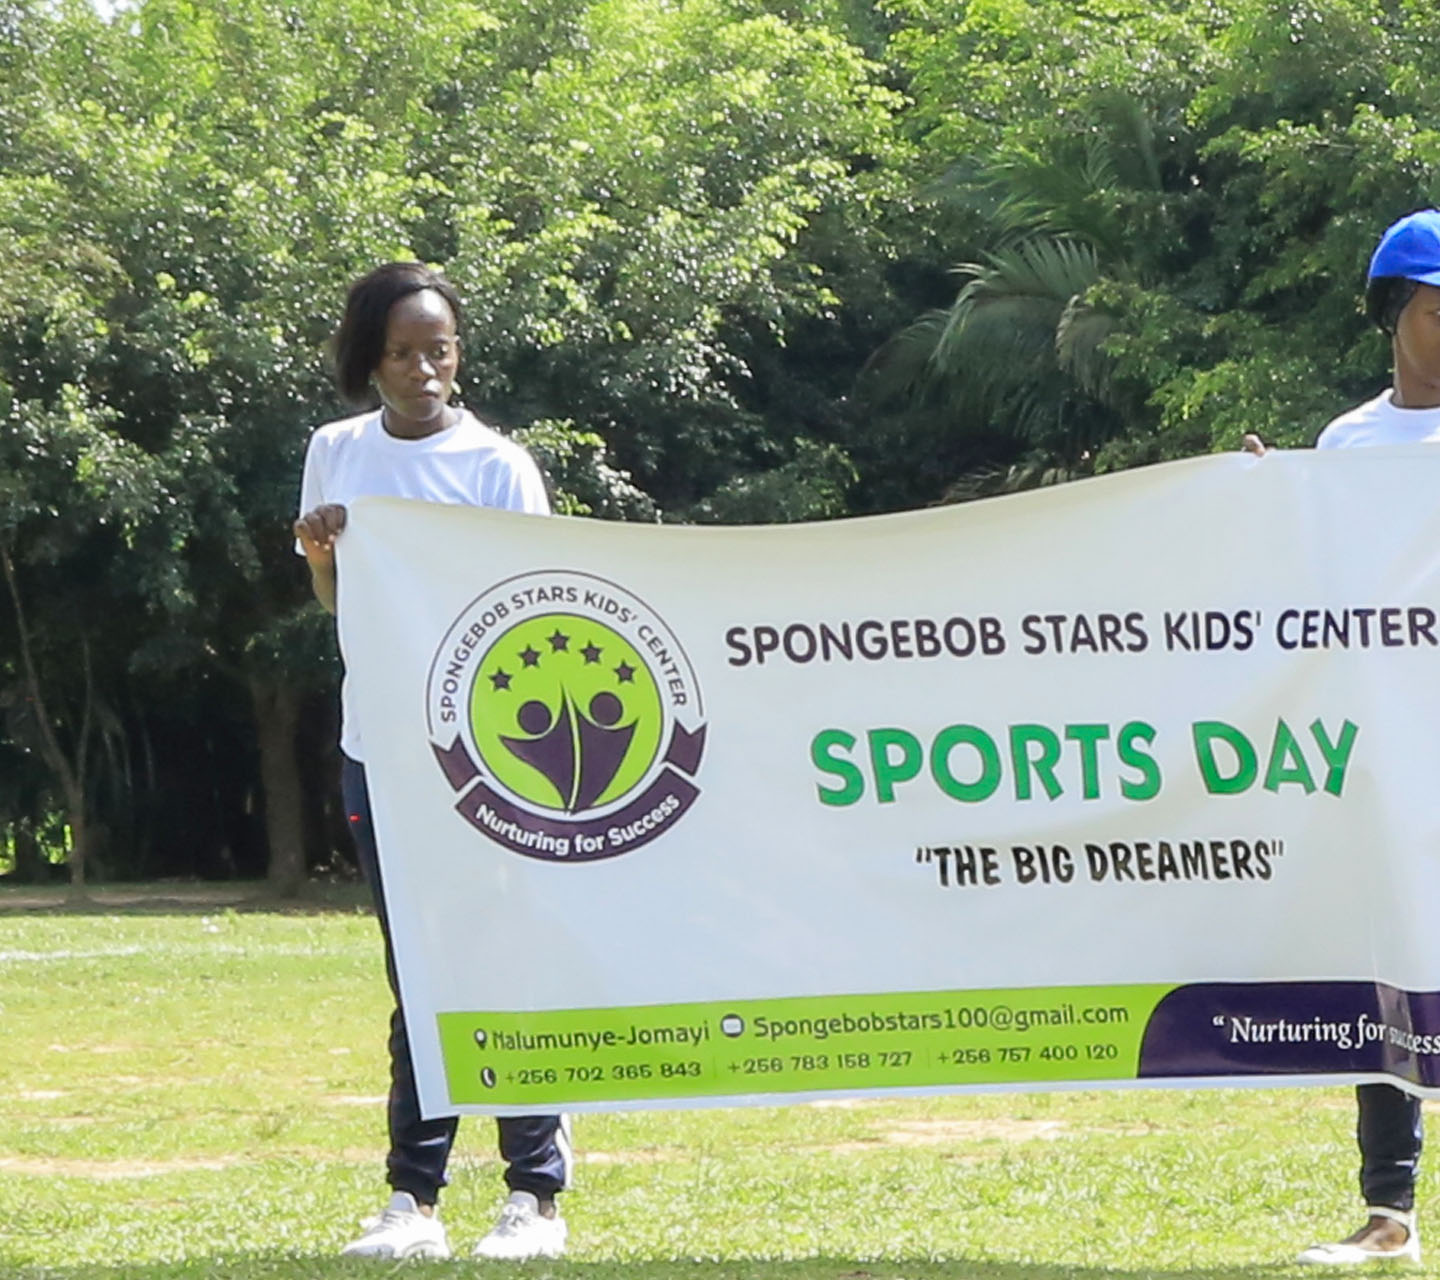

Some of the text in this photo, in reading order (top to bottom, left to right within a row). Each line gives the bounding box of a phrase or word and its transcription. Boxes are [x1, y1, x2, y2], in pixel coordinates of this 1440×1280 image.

[440, 601, 510, 723] SPONGEBOB
[511, 586, 578, 610] STARS
[637, 624, 688, 708] CENTER
[725, 606, 1439, 666] SPONGEBOB STARS KIDS' CENTER
[811, 716, 1359, 807] SPORTS DAY
[475, 793, 681, 856] Nurturing for Success
[916, 839, 1284, 887] "THE BIG DREAMERS"
[754, 1004, 1129, 1041] Spongebobstars100@gmail.com
[1354, 1013, 1386, 1049] for
[506, 1043, 1118, 1085] +256 702 365 843 +256 783 158 727 +256 757 400 120
